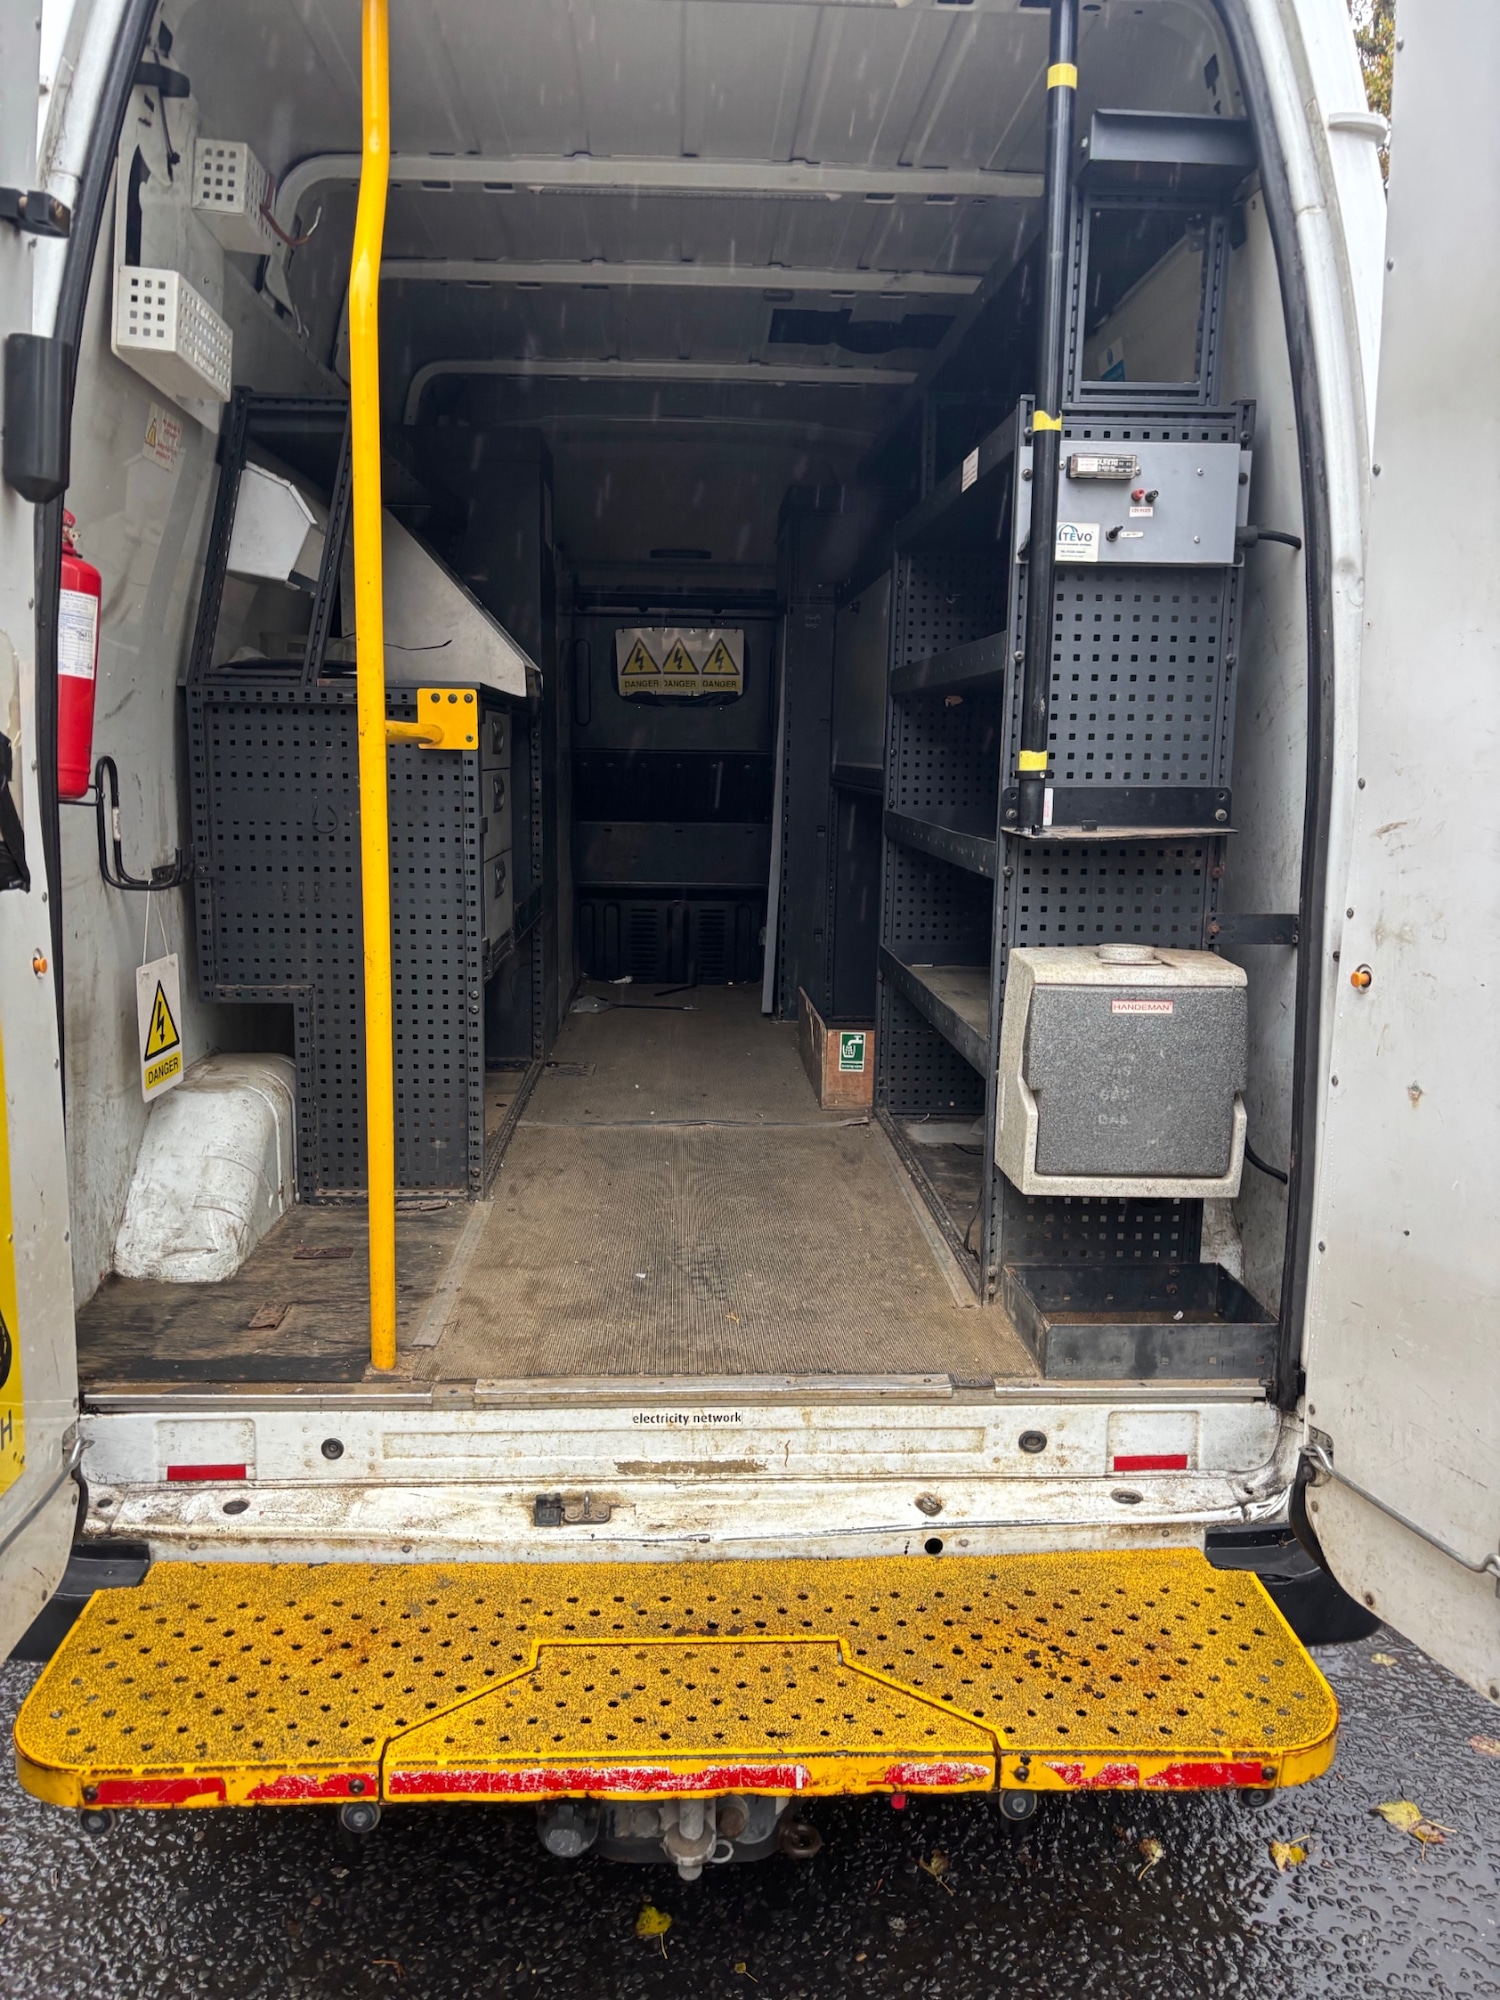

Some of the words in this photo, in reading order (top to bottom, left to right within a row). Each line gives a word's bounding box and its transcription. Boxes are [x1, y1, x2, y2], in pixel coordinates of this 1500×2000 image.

[624, 680, 659, 688] DANGER
[702, 680, 737, 688] DANGER
[1113, 1003, 1170, 1011] HANDEMAN
[147, 1057, 179, 1084] DANGER
[632, 1412, 690, 1426] electricity
[693, 1411, 742, 1423] network
